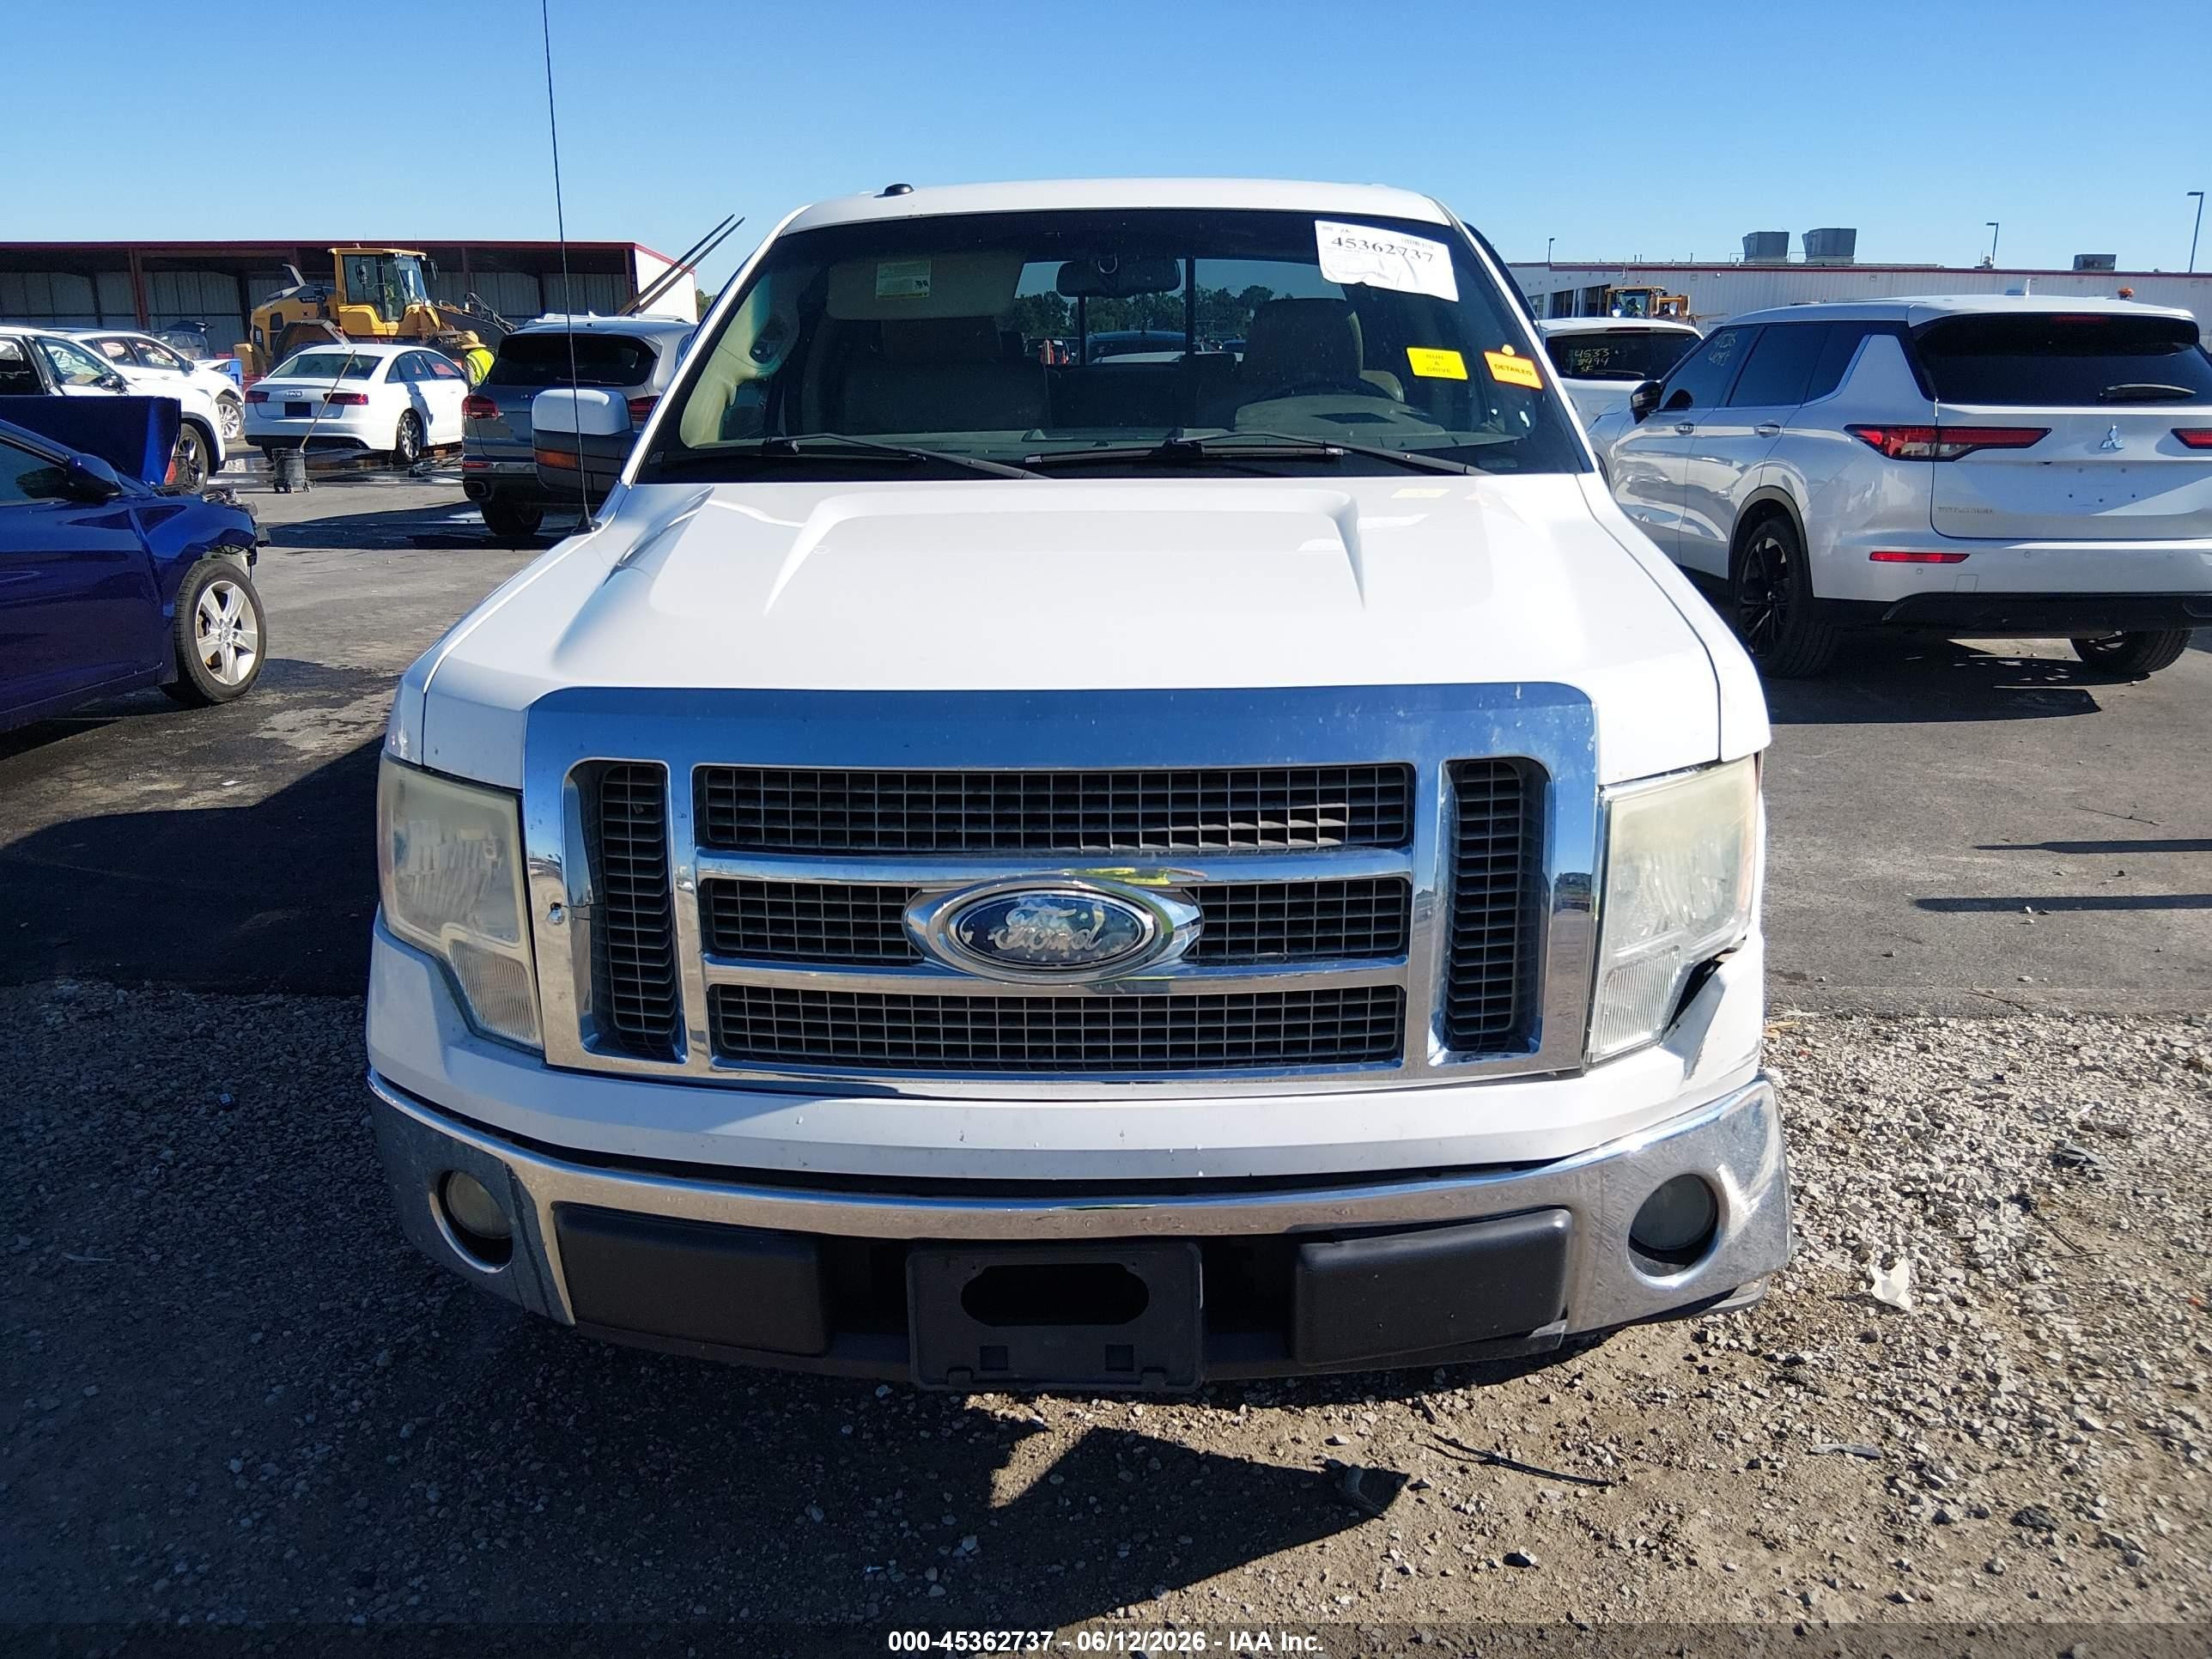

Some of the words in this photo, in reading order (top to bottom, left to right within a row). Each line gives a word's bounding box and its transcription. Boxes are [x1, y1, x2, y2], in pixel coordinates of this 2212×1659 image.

[1332, 237, 1433, 262] 45362737
[1574, 348, 1610, 357] 4533
[1494, 363, 1534, 377] DETAILED
[994, 902, 1105, 951] Ford
